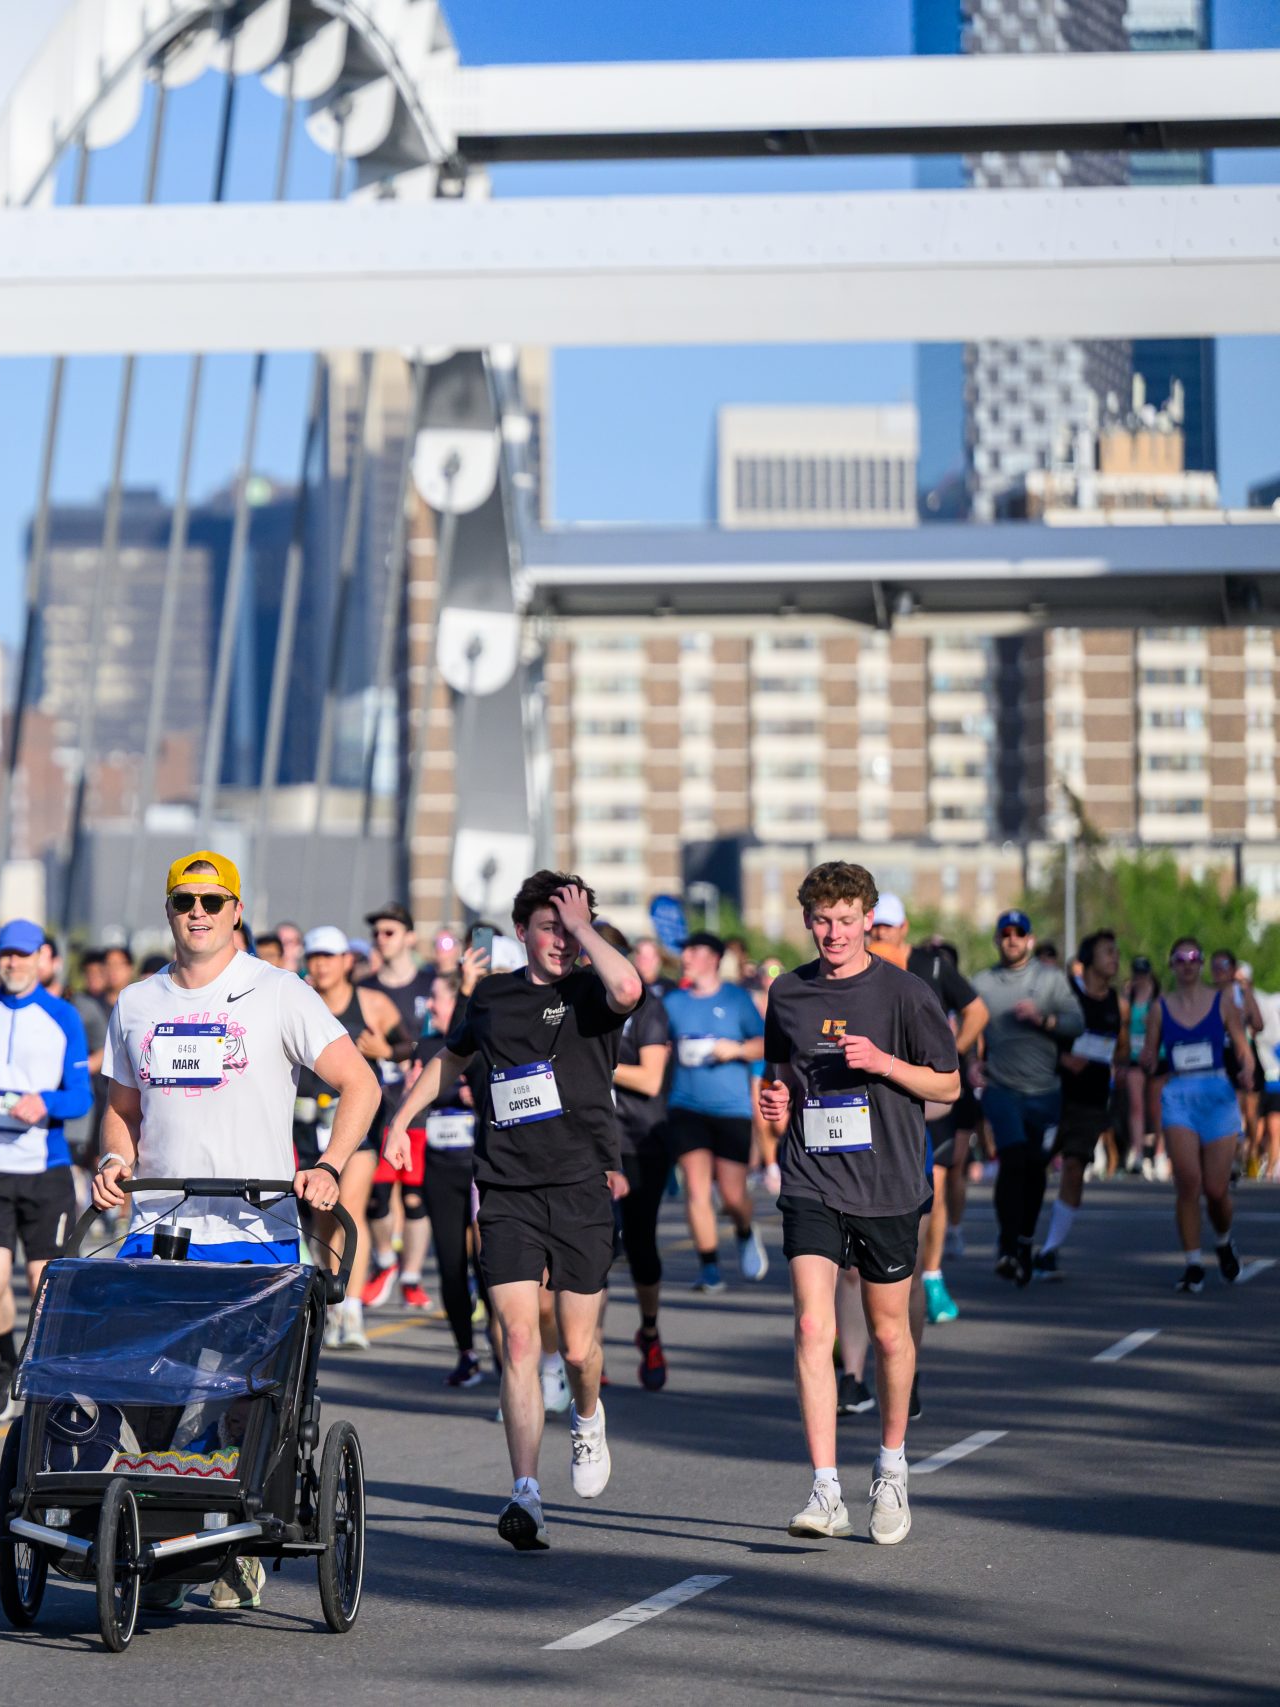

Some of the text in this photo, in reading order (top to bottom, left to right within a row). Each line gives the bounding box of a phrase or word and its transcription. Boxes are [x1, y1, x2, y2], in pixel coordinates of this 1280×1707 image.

[178, 1045, 197, 1053] 6458
[172, 1059, 200, 1070] MARK
[509, 1096, 541, 1111] CAYSEN
[829, 1128, 843, 1139] ELI
